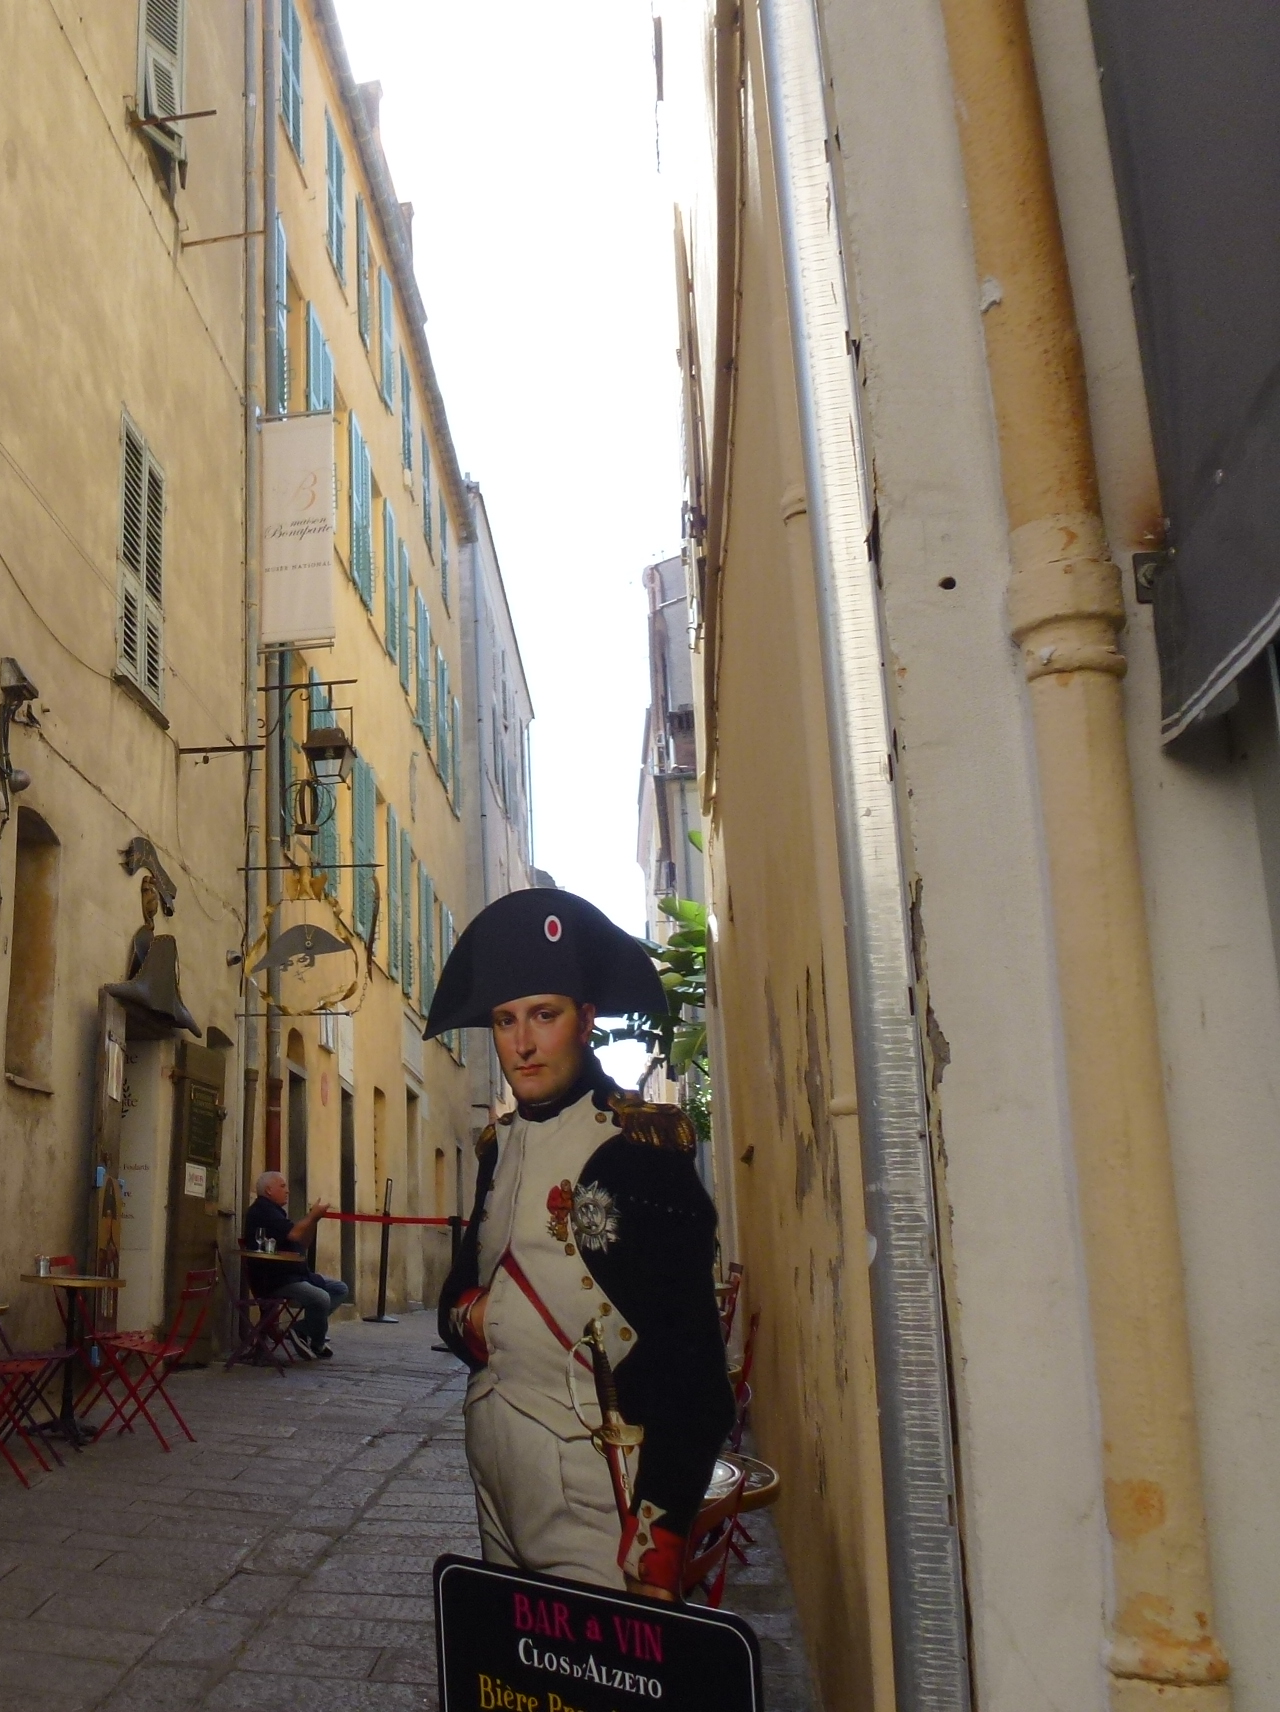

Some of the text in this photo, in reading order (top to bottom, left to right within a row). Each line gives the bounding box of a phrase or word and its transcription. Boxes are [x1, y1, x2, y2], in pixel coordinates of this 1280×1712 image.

[264, 523, 333, 542] Bonaparte
[291, 560, 332, 571] NATIONAL
[512, 1591, 665, 1664] BAR à VIN
[478, 1673, 539, 1712] Bière
